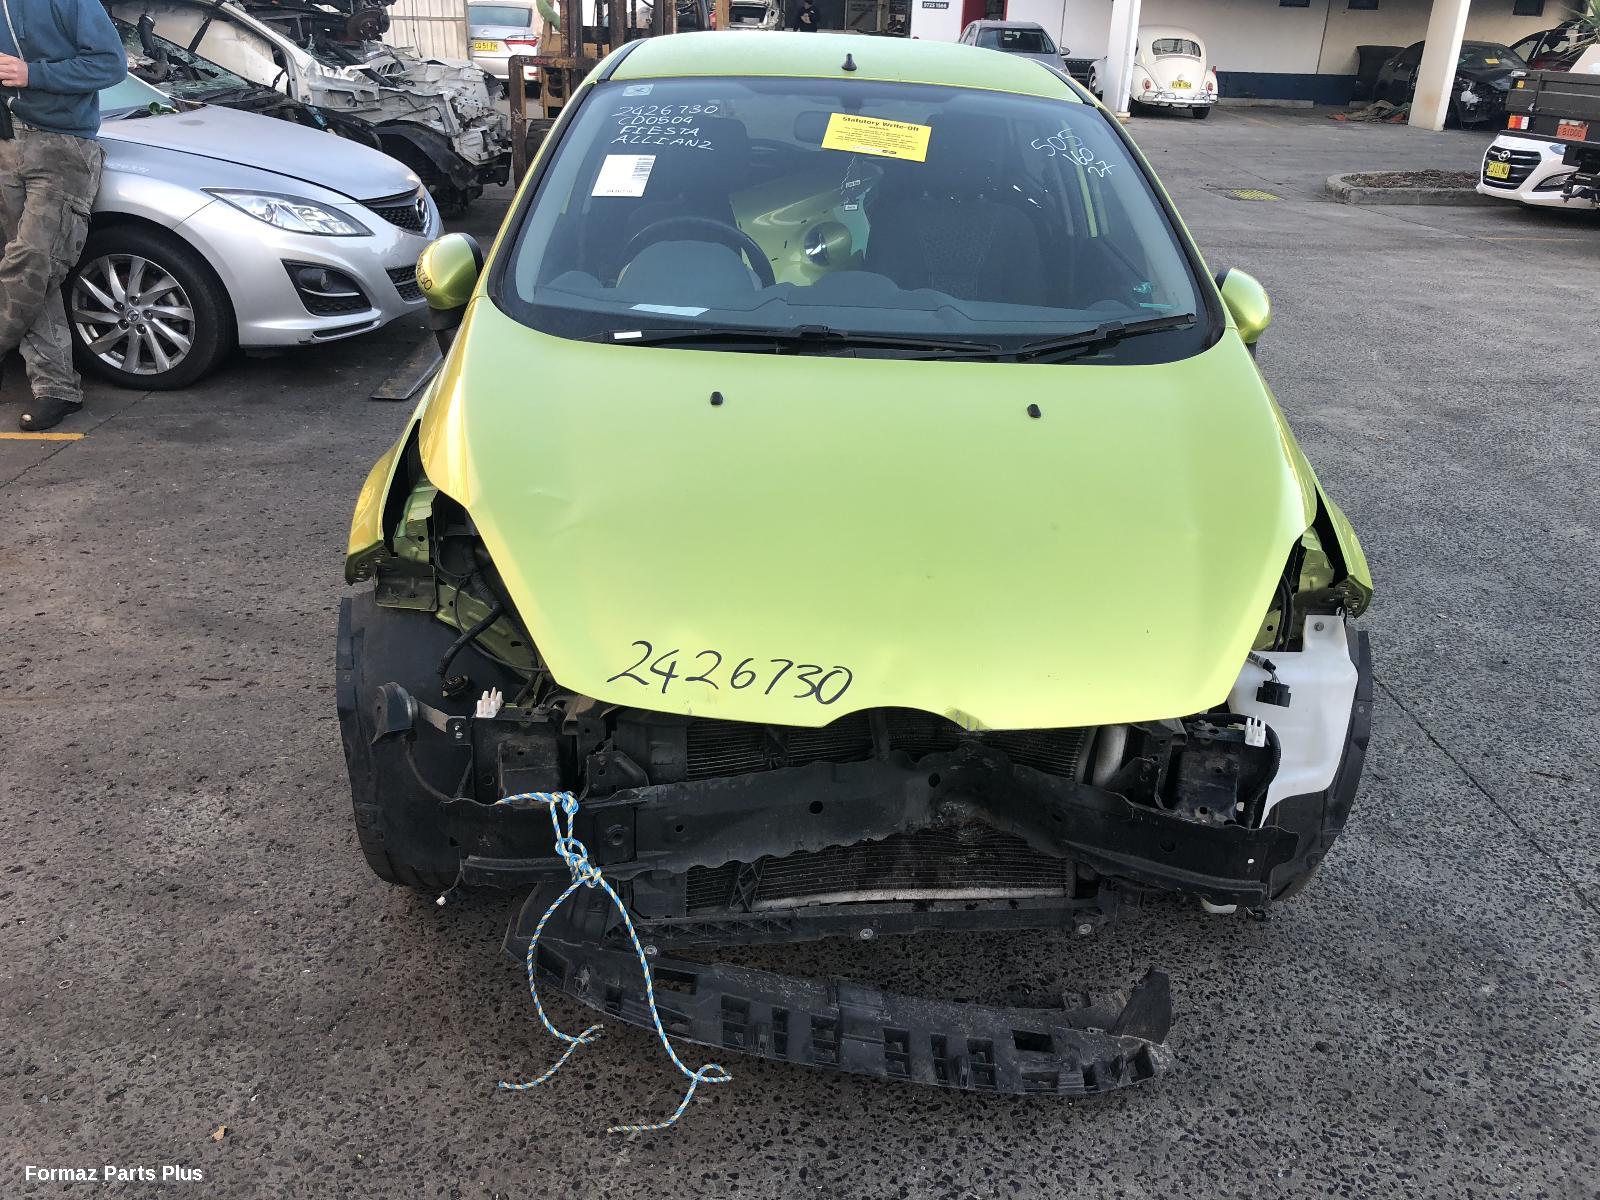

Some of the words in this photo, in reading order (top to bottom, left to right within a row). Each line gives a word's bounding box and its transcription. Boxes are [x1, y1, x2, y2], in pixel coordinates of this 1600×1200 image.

[611, 104, 719, 117] 2426730
[842, 116, 880, 127] Statutory
[619, 126, 700, 136] FIESTA
[1031, 127, 1083, 157] 505
[1087, 160, 1117, 178] 27
[606, 640, 853, 705] 2426730
